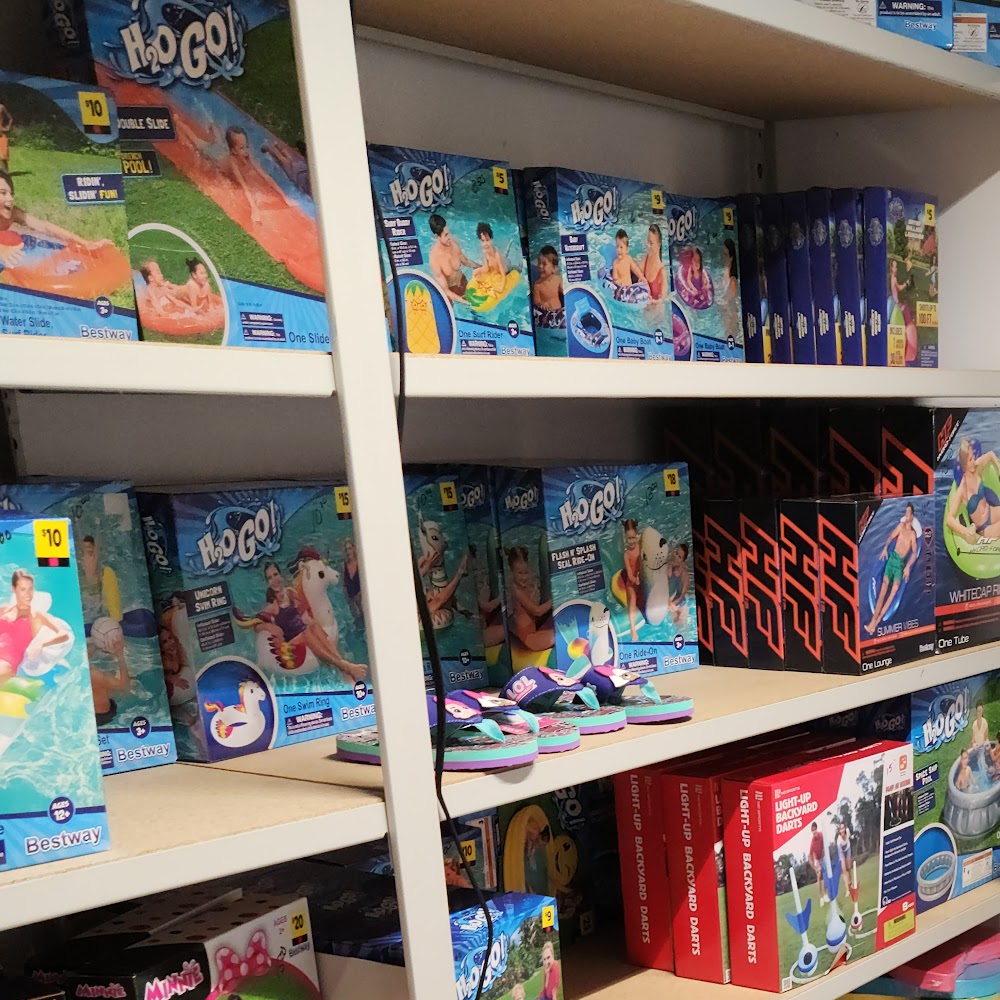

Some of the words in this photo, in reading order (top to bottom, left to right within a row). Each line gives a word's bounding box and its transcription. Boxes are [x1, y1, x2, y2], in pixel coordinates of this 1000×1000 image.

[904, 21, 937, 31] Bestway
[85, 99, 104, 118] $10
[145, 117, 170, 130] SLIDE
[123, 159, 153, 176] POOL!
[80, 324, 133, 342] Bestway
[288, 332, 305, 345] One
[306, 333, 331, 346] Slide
[486, 331, 504, 340] Rider
[500, 346, 532, 356] Bestway
[42, 528, 62, 547] $10
[557, 558, 571, 570] SEAL
[194, 586, 223, 601] UNICORN
[949, 586, 993, 604] WHITECAP
[194, 600, 211, 613] SWIM
[211, 597, 228, 609] RING
[877, 624, 903, 638] SUMMER
[903, 619, 919, 633] VIBES
[938, 638, 953, 649] One
[953, 634, 970, 646] Tube
[619, 651, 632, 661] One
[633, 647, 658, 659] Ride-On
[663, 653, 697, 668] Bestway
[862, 661, 874, 673] One
[873, 657, 893, 670] Lounge
[283, 702, 297, 714] One
[297, 699, 316, 712] Swim
[316, 697, 331, 710] Ring
[135, 725, 147, 737] 3+
[117, 741, 172, 763] Bestway
[51, 800, 69, 813] AGES
[629, 772, 641, 829] LIGHT-UP
[775, 791, 812, 812] LIGHT-UP
[53, 809, 71, 822] 12+
[679, 782, 693, 842] LIGHT-UP
[740, 788, 751, 848] LIGHT-UP
[775, 801, 819, 824] BACKYARD
[776, 820, 803, 835] DARTS
[25, 826, 102, 854] Bestway
[634, 834, 649, 908] BACKYARD
[684, 845, 698, 912] BACKYARD
[743, 852, 755, 920] BACKYARD
[640, 913, 651, 944] DARTS
[690, 915, 701, 956] DARTS
[746, 923, 758, 965] DARTS
[76, 983, 127, 998] MINNIE
